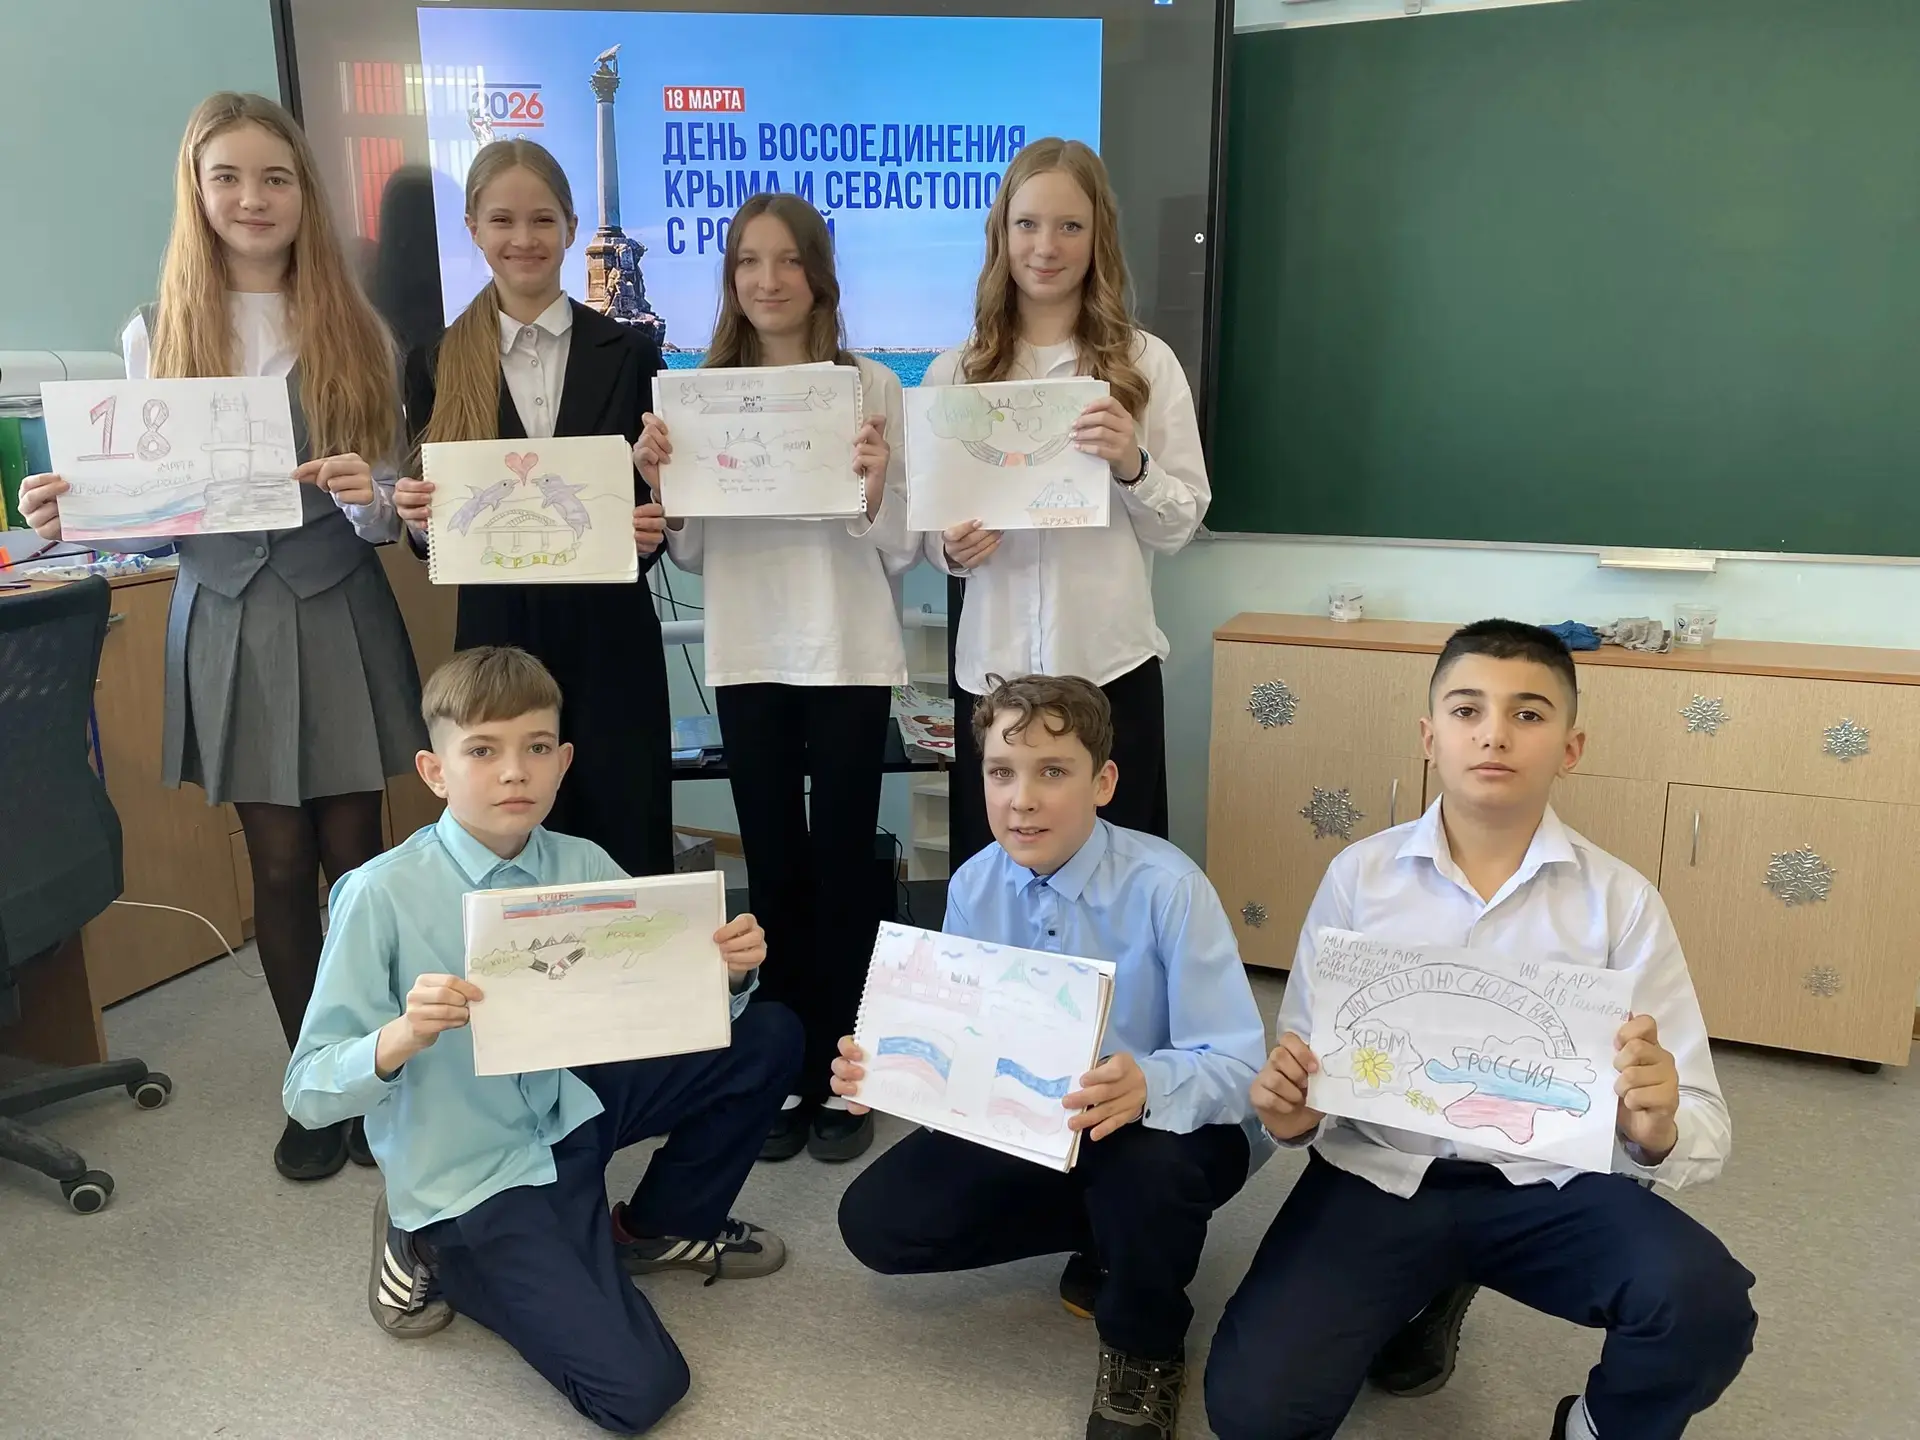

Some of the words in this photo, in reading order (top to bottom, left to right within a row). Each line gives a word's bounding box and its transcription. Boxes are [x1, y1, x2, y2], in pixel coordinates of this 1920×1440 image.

[471, 91, 544, 119] 2026
[666, 88, 684, 110] 18
[688, 89, 742, 110] МАРТА
[662, 121, 747, 165] ДЕНЬ
[758, 122, 1026, 167] ВОССОЕДИНЕНИЯ
[667, 216, 686, 255] С
[78, 396, 171, 461] 18
[1351, 1029, 1406, 1052] КРЫМ
[1467, 1052, 1555, 1091] РОССИЯ
